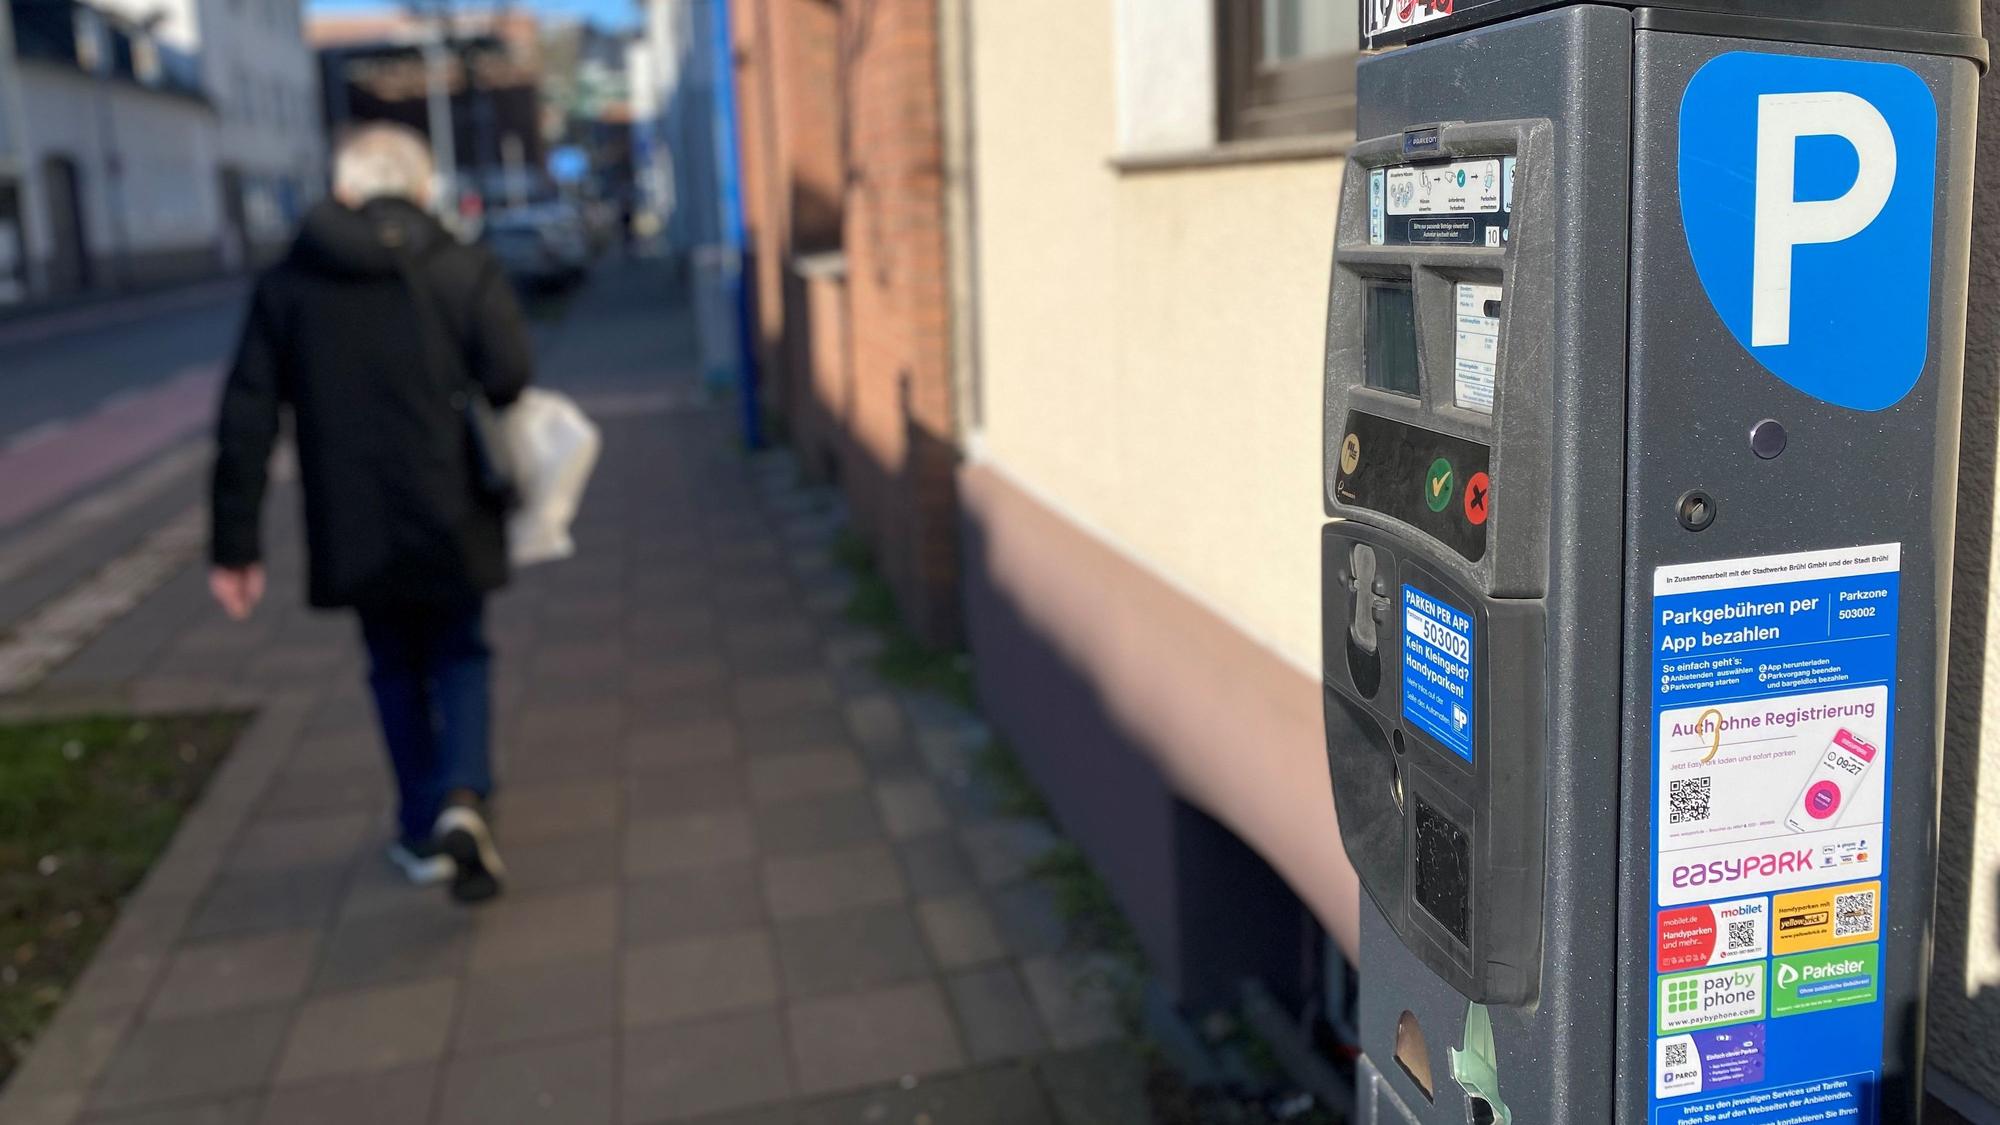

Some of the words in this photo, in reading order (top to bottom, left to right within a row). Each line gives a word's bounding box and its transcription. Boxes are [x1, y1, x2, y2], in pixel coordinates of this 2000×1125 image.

[1752, 90, 1897, 348] P
[1487, 230, 1498, 244] 10
[1666, 576, 1673, 584] In
[1674, 571, 1728, 584] Zusammenarbeit
[1740, 568, 1751, 576] der
[1752, 564, 1788, 576] Stadtwerke
[1788, 562, 1806, 572] Brühl
[1808, 561, 1828, 570] GmbH
[1828, 560, 1841, 568] und
[1842, 558, 1853, 566] der
[1854, 556, 1870, 565] Stadt
[1872, 554, 1889, 564] Brühl
[1839, 588, 1888, 602] Parkzone
[1406, 590, 1436, 617] PARKEN
[1437, 605, 1452, 626] PER
[1452, 614, 1470, 634] APP
[1662, 600, 1785, 626] Parkgebühren
[1789, 596, 1820, 615] per
[1838, 607, 1876, 620] 503002
[1423, 620, 1468, 661] 503002
[1660, 634, 1696, 652] App
[1702, 625, 1780, 647] bezahlen
[1406, 634, 1424, 656] Kein
[1425, 645, 1470, 682] Kleingeld?
[1662, 664, 1675, 674] So
[1676, 660, 1710, 672] einfach
[1767, 664, 1782, 672] App
[1783, 658, 1830, 670] herunterladen
[1406, 652, 1464, 699] Handyparken!
[1670, 672, 1714, 682] Anbietenden
[1716, 666, 1754, 677] auswählen
[1766, 681, 1781, 689] und
[1781, 677, 1818, 688] bargeldlos
[1818, 674, 1849, 683] bezahlen
[1767, 669, 1811, 680] Parkvorgang
[1812, 666, 1842, 675] beenden
[1670, 680, 1714, 691] Parkvorgang
[1715, 677, 1740, 686] starten
[1672, 719, 1715, 737] Auch
[1719, 715, 1761, 731] ohne
[1765, 702, 1876, 728] Registrierung
[1670, 762, 1686, 771] Jetzt
[1718, 756, 1737, 765] laden
[1738, 754, 1752, 762] und
[1752, 752, 1772, 760] sofort
[1772, 750, 1797, 760] parken
[1836, 756, 1863, 776] 09:27
[1720, 904, 1763, 918] mobilet
[1778, 904, 1819, 914] Handyparken
[1664, 916, 1698, 927] mobilet.de
[1780, 915, 1820, 930] yellowbrick
[1663, 927, 1713, 940] Handyparken
[1662, 940, 1678, 950] und
[1802, 960, 1865, 981] Parkster
[1704, 990, 1756, 1011] phone
[1668, 1009, 1756, 1028] www.paybyphone.com
[1706, 1052, 1726, 1061] Einfach
[1740, 1048, 1759, 1056] Parken
[1684, 1104, 1704, 1115] Infos
[1704, 1104, 1715, 1112] zu
[1716, 1100, 1732, 1110] den
[1732, 1094, 1771, 1108] jeweiligen
[1772, 1088, 1804, 1100] Services
[1806, 1085, 1821, 1094] und
[1822, 1080, 1848, 1092] Tarifen
[1678, 1116, 1702, 1125] finden
[1704, 1114, 1716, 1123] Sie
[1718, 1112, 1732, 1120] auf
[1732, 1110, 1746, 1118] den
[1748, 1102, 1788, 1115] Webseiten
[1790, 1100, 1802, 1108] der
[1803, 1091, 1853, 1106] Anbietenden.
[1776, 1113, 1825, 1125] kontaktieren
[1825, 1110, 1838, 1119] Sie
[1838, 1106, 1859, 1117] Ihren
